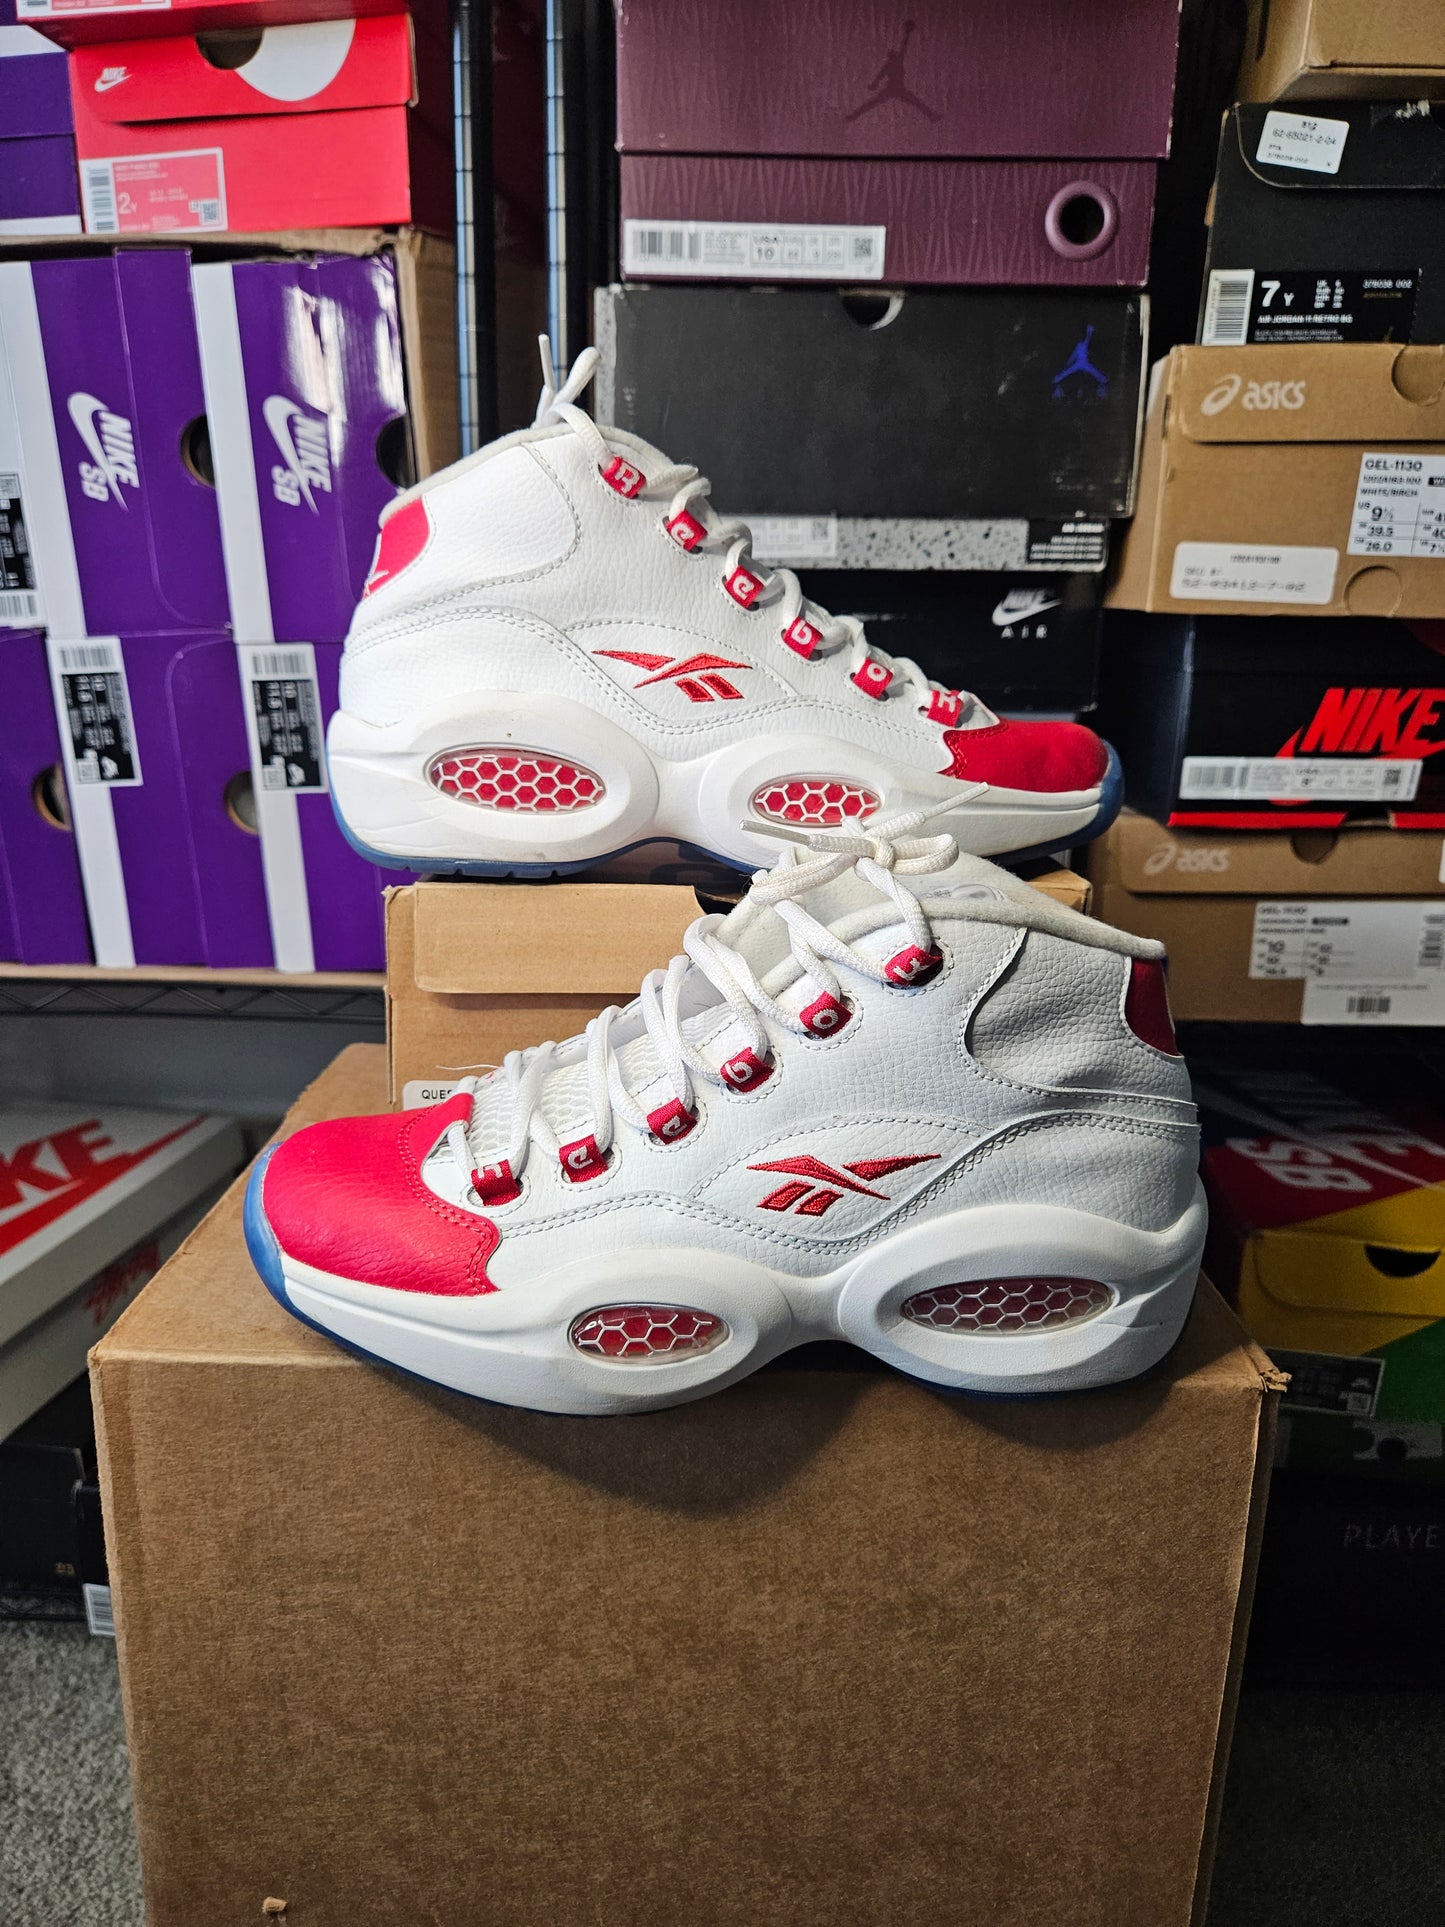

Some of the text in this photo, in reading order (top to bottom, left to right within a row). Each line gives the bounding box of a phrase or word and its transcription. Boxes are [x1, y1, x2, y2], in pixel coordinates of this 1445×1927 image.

[1261, 280, 1281, 307] 7
[1283, 292, 1295, 307] Y
[99, 410, 140, 489] NIKE
[292, 414, 332, 494] NIKE
[1365, 458, 1423, 472] GEL-1130
[78, 461, 109, 502] SB
[271, 465, 301, 507] SB
[1000, 623, 1048, 640] AIR
[1298, 688, 1445, 753] NIKE
